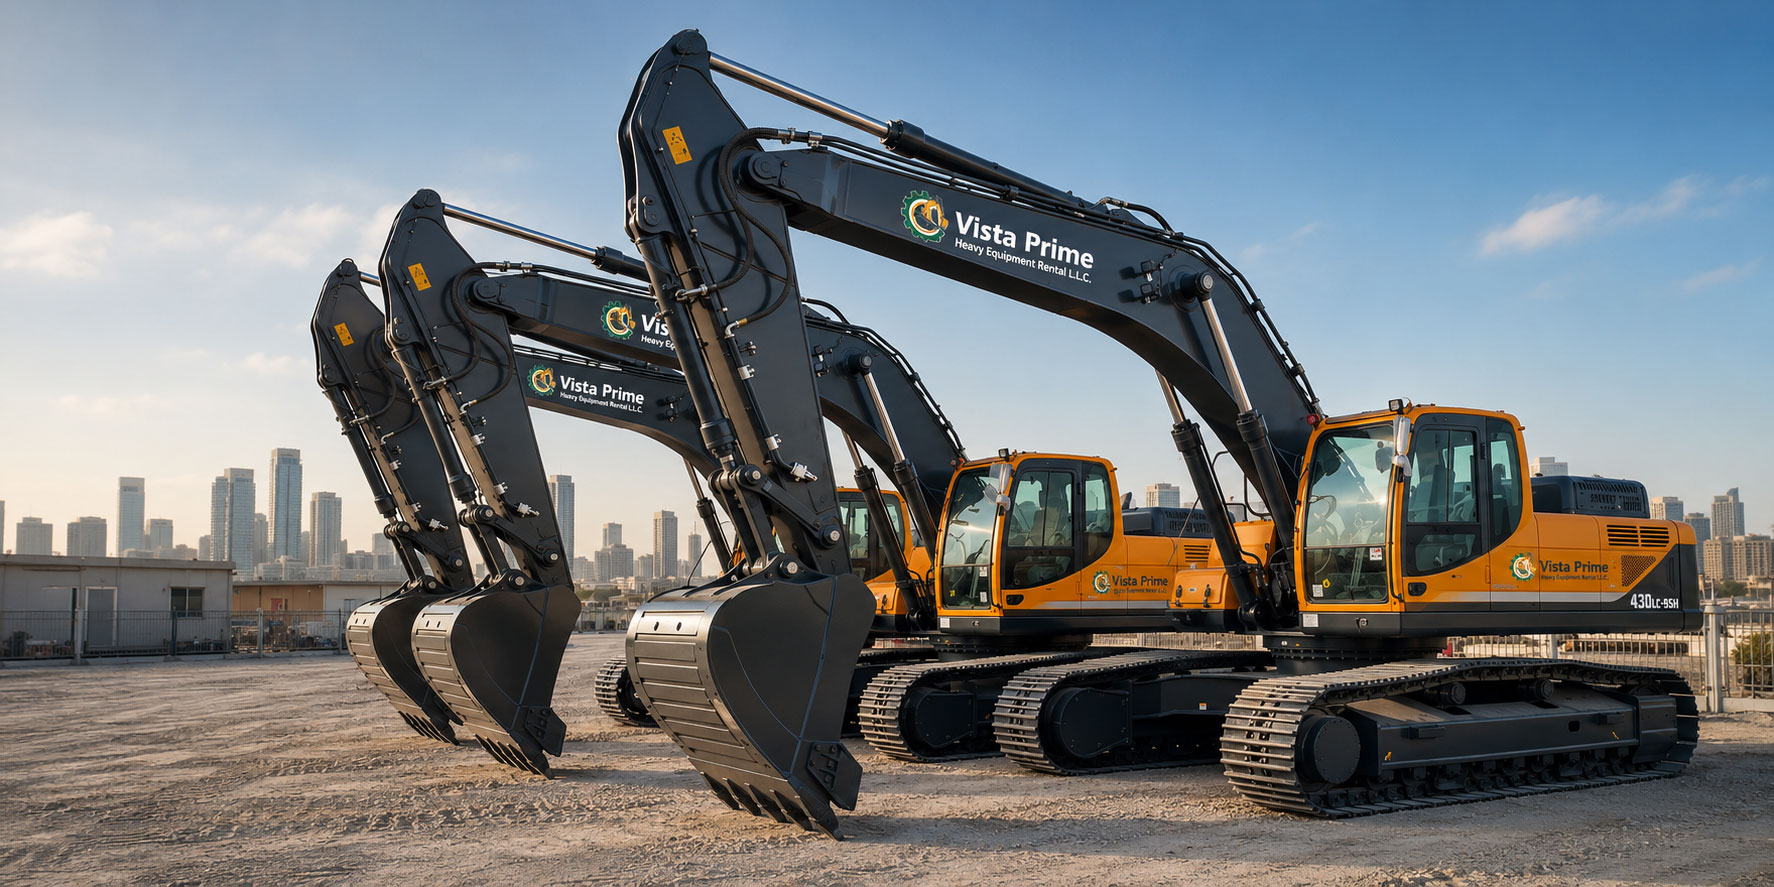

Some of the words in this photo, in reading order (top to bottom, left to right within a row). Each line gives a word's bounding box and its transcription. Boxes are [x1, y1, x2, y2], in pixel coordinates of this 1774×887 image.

[955, 211, 1016, 248] Vista
[1025, 231, 1094, 269] Prime
[955, 237, 984, 256] Heavy
[986, 247, 1036, 268] Equipment
[1038, 261, 1067, 277] Rental
[1069, 269, 1092, 284] L.L.C.
[641, 314, 669, 336] Vis
[641, 334, 664, 348] Heavy
[560, 375, 597, 396] Vista
[602, 383, 645, 404] Prime
[609, 401, 628, 411] Rental
[1539, 560, 1570, 572] Vista
[1574, 560, 1608, 573] Prime
[1112, 575, 1138, 586] Vista
[1140, 575, 1168, 586] Prime
